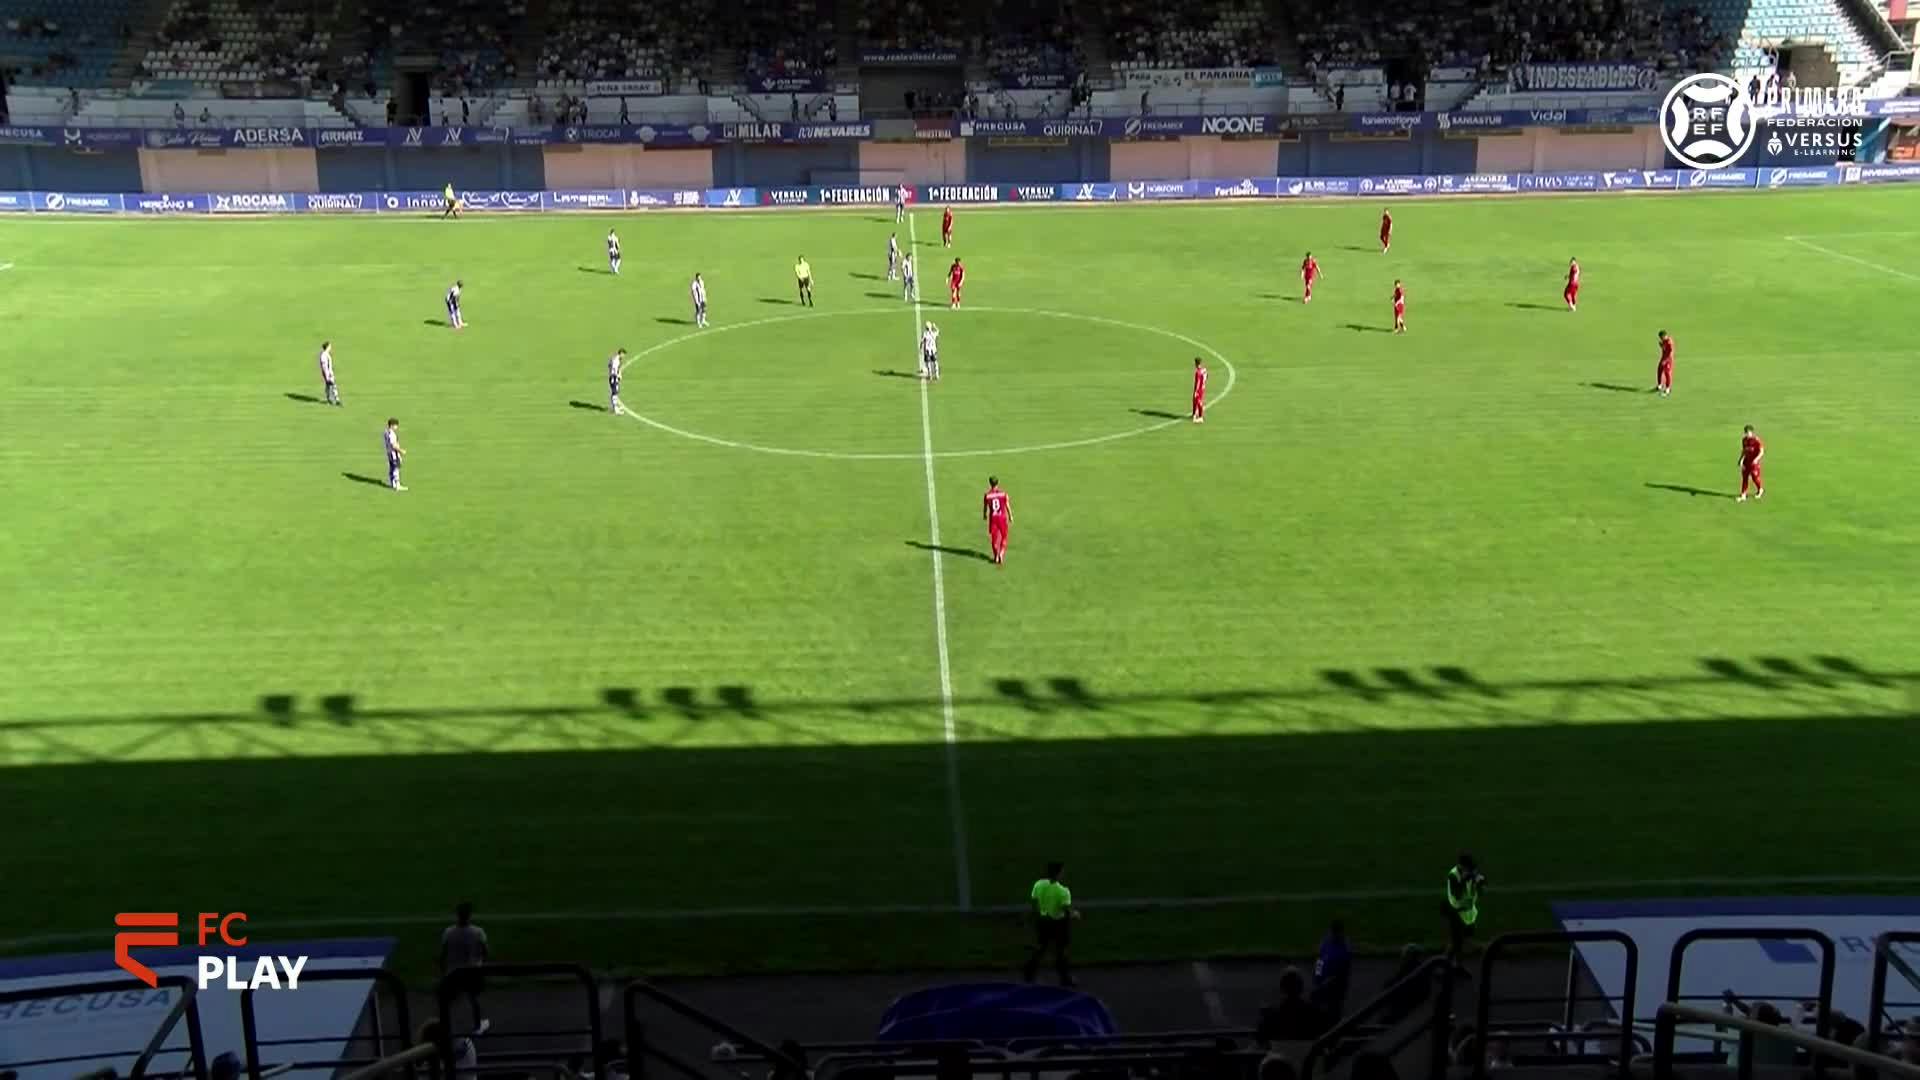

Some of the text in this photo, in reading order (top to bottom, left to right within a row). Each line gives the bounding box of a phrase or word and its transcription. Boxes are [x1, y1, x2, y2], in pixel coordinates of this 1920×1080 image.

[1527, 65, 1637, 90] INDESEABLES
[1530, 109, 1567, 121] Vidal
[738, 124, 781, 138] MILAR
[1043, 123, 1096, 136] QUIRINAL
[1202, 116, 1264, 133] NOONE
[233, 127, 304, 142] ADERSA
[771, 191, 808, 199] VERSUS
[832, 187, 890, 203] FEDERACIÓN
[940, 185, 998, 200] FEDERACIÓN
[1018, 187, 1055, 196] VERSUS
[232, 195, 286, 206] ROCASA
[407, 199, 449, 208] Innov
